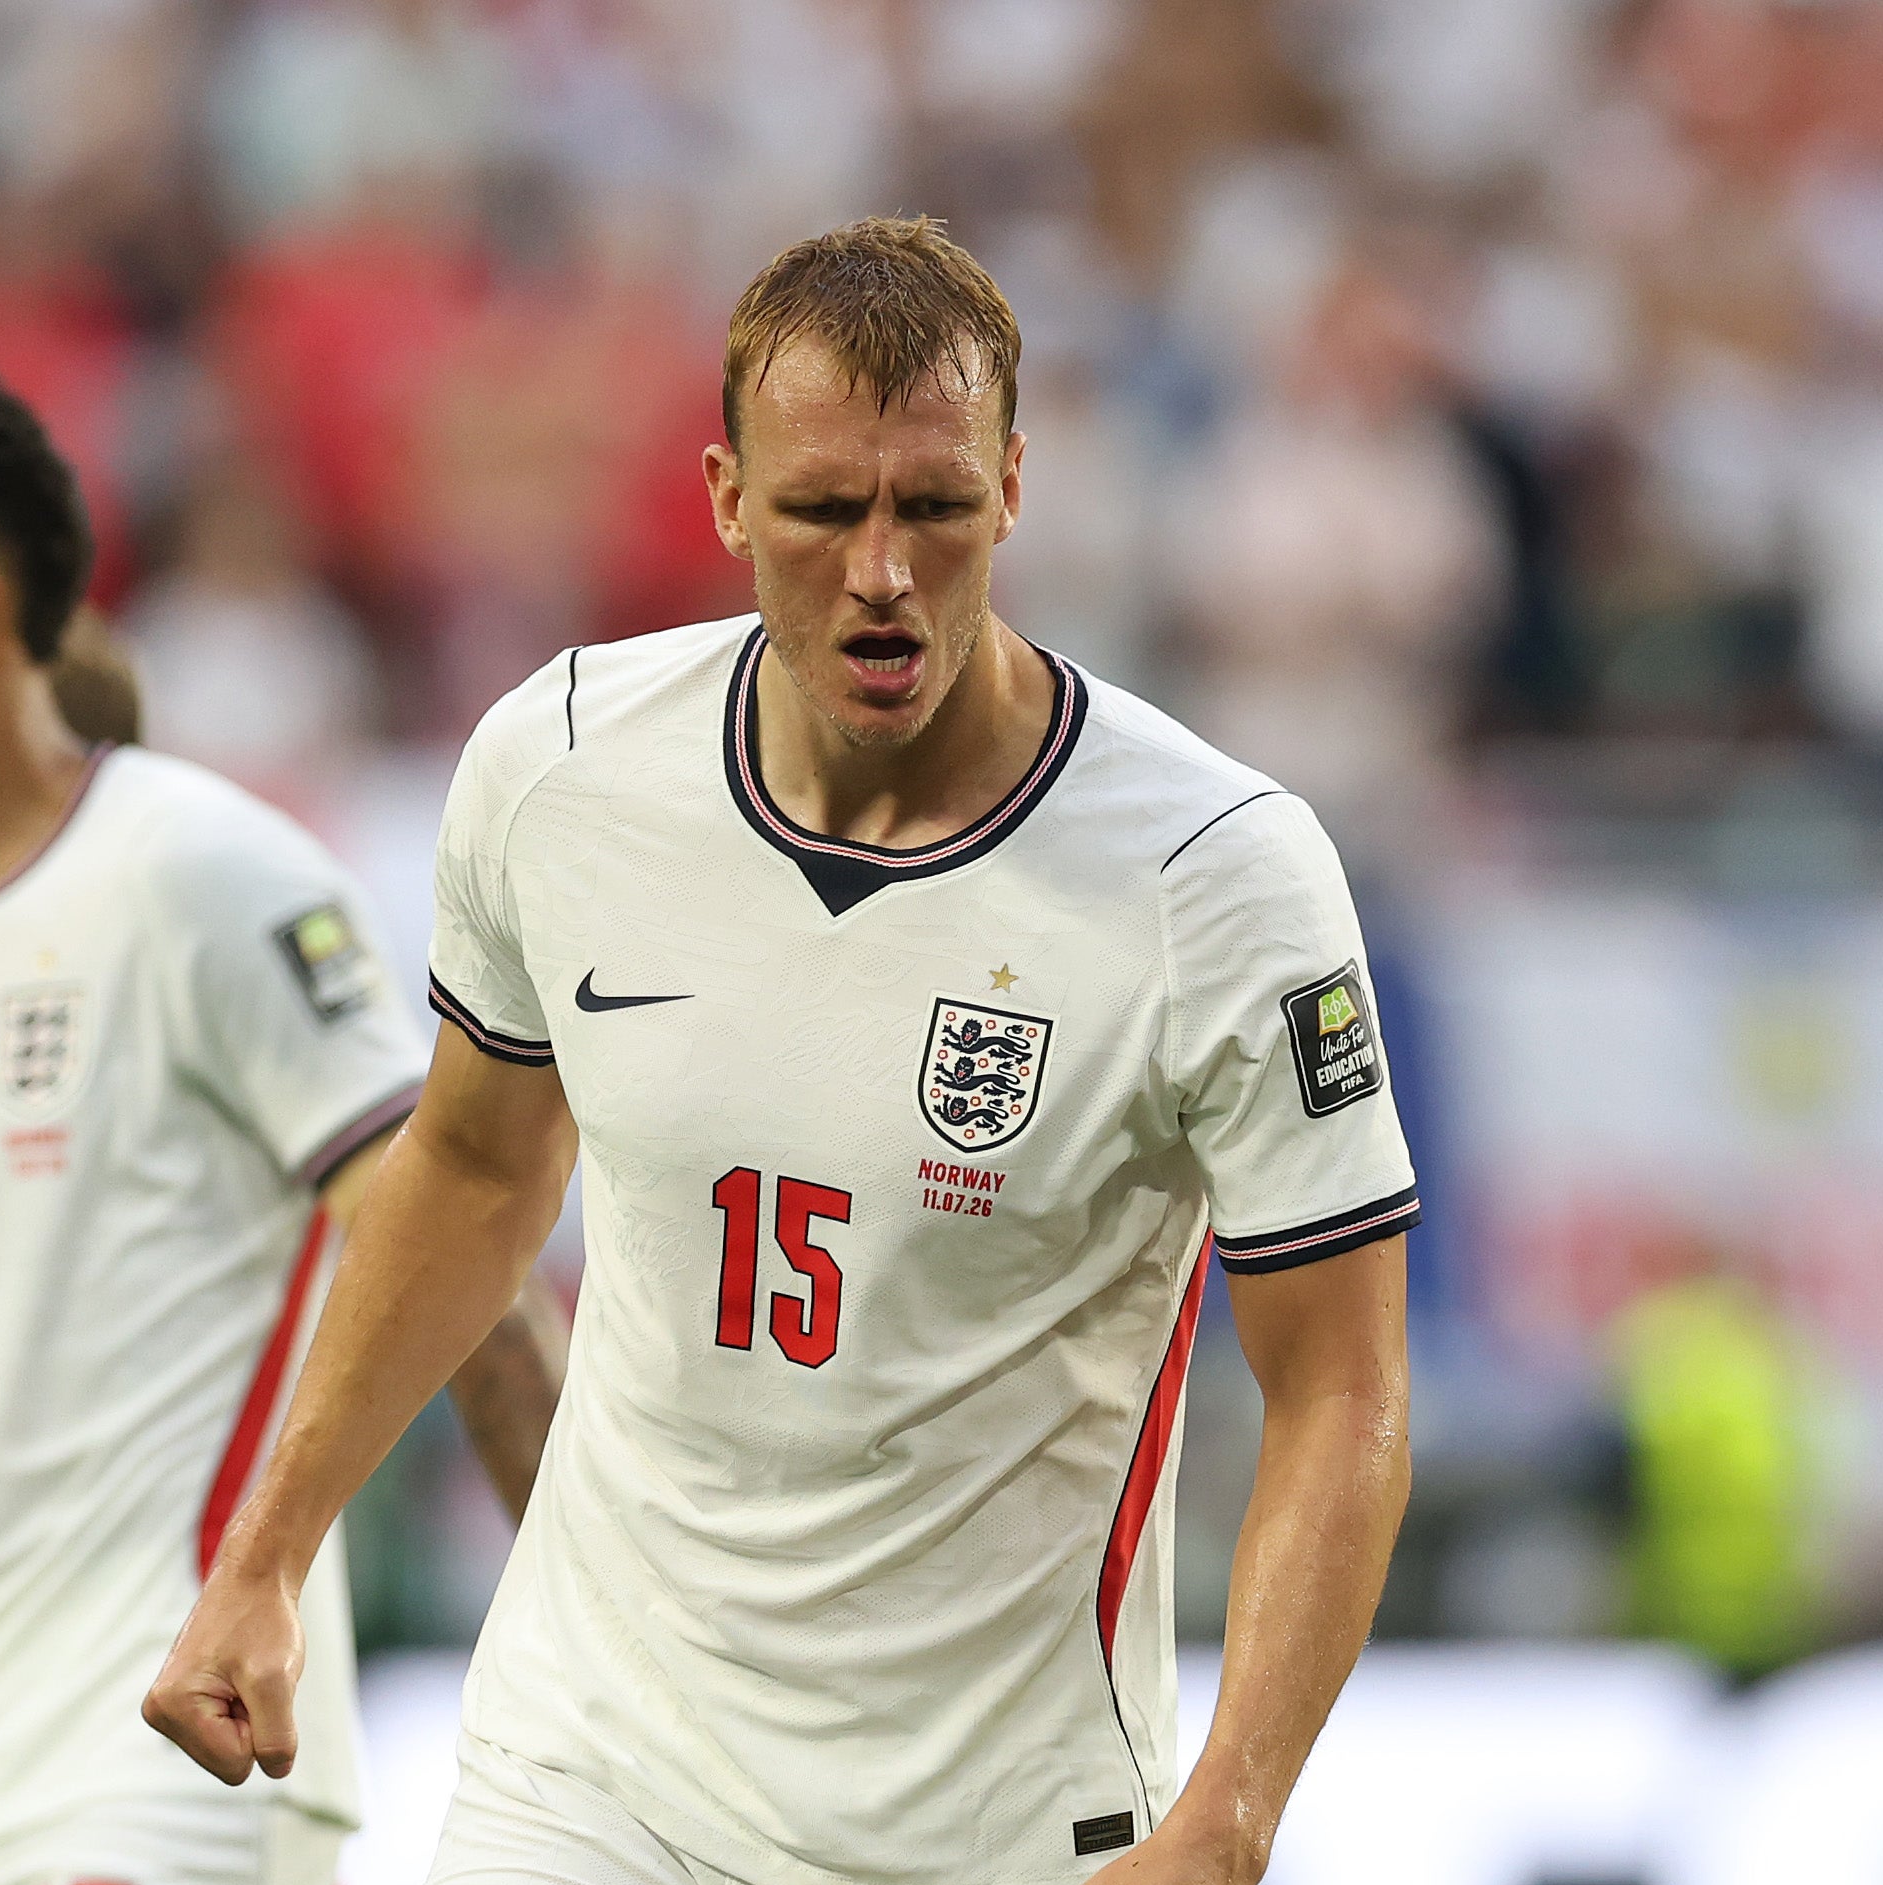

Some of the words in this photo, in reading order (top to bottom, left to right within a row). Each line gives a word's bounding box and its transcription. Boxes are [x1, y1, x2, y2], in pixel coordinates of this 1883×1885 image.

[1320, 1033, 1350, 1062] Unite
[1348, 1022, 1364, 1048] For
[1341, 1074, 1365, 1092] FIFA
[918, 1158, 1006, 1194] NORWAY
[922, 1187, 993, 1218] 11.07.26
[712, 1165, 852, 1369] 15
